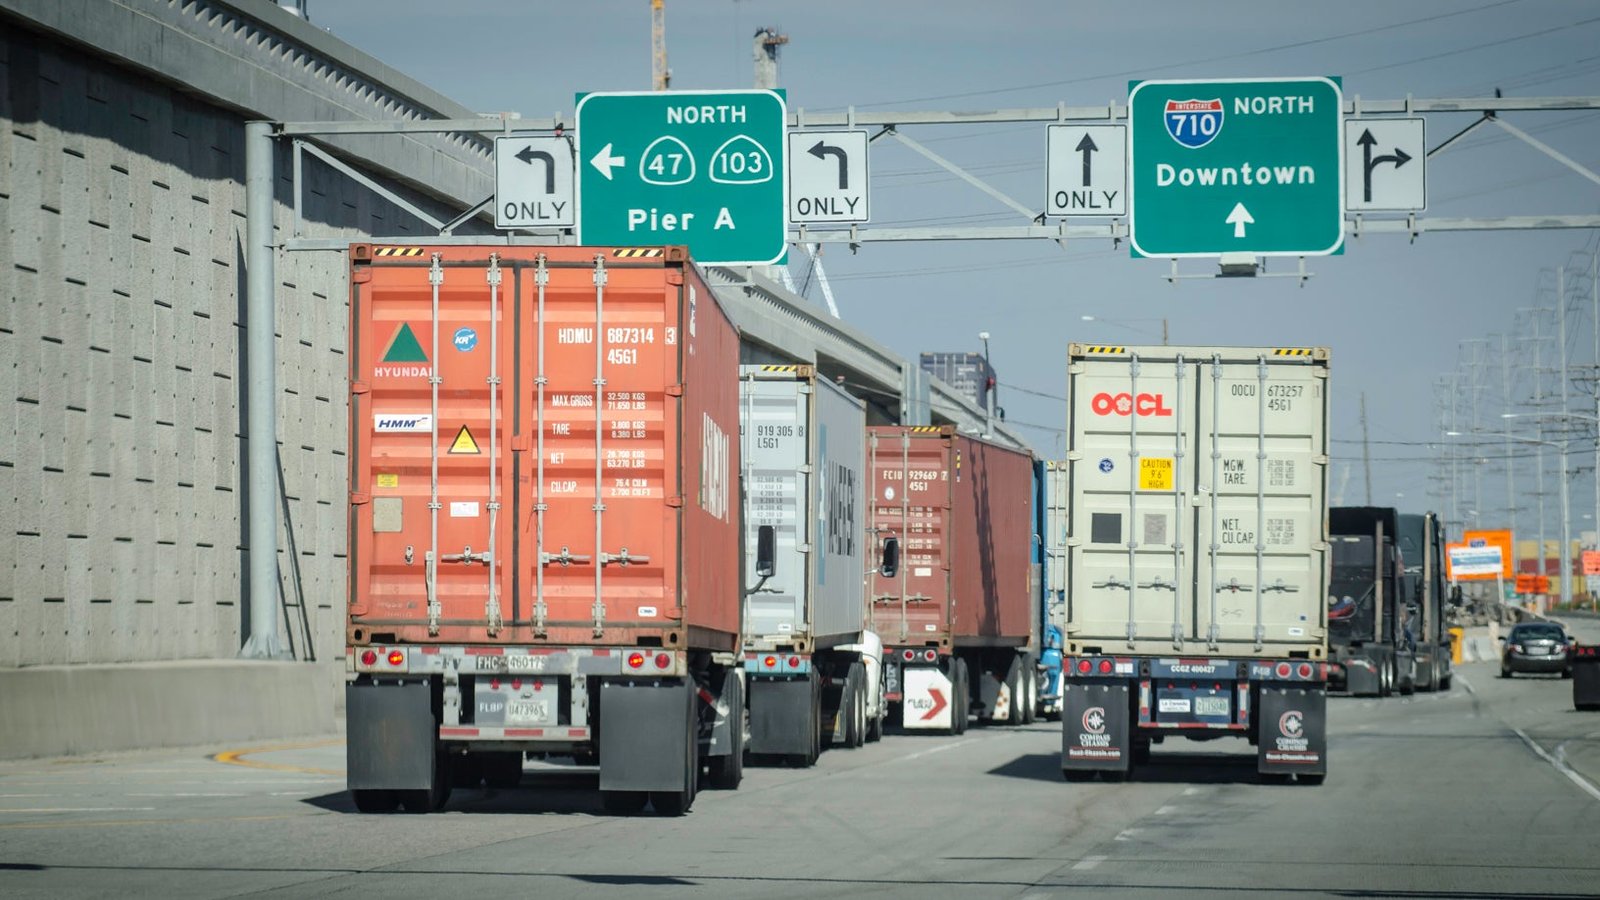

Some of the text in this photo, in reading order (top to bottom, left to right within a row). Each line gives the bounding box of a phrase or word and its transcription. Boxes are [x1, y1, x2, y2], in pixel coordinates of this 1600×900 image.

[1234, 96, 1314, 115] NORTH
[667, 106, 746, 124] NORTH
[1172, 113, 1216, 136] 710
[648, 152, 763, 175] 47 103
[1156, 163, 1315, 187] Downtown
[797, 196, 860, 215] ONLY
[1055, 190, 1118, 209] ONLY
[504, 201, 566, 220] ONLY
[628, 207, 735, 231] Pier A
[558, 328, 676, 344] HDMU 687314 3
[607, 349, 637, 364] 45G1
[374, 367, 433, 377] HYUNDAI
[1267, 385, 1303, 397] 673257
[1091, 393, 1172, 416] OOCL
[1268, 399, 1291, 411] 45G1
[378, 419, 416, 428] HMM
[552, 423, 571, 435] TARE
[757, 426, 775, 436] 919
[776, 426, 793, 436] 305
[798, 427, 804, 437] 8
[757, 438, 779, 448] L5G1
[550, 452, 565, 464] NET
[1142, 460, 1171, 469] CAUTION
[908, 471, 937, 480] 929669
[1148, 480, 1164, 488] HIGH
[477, 655, 508, 670] FHC
